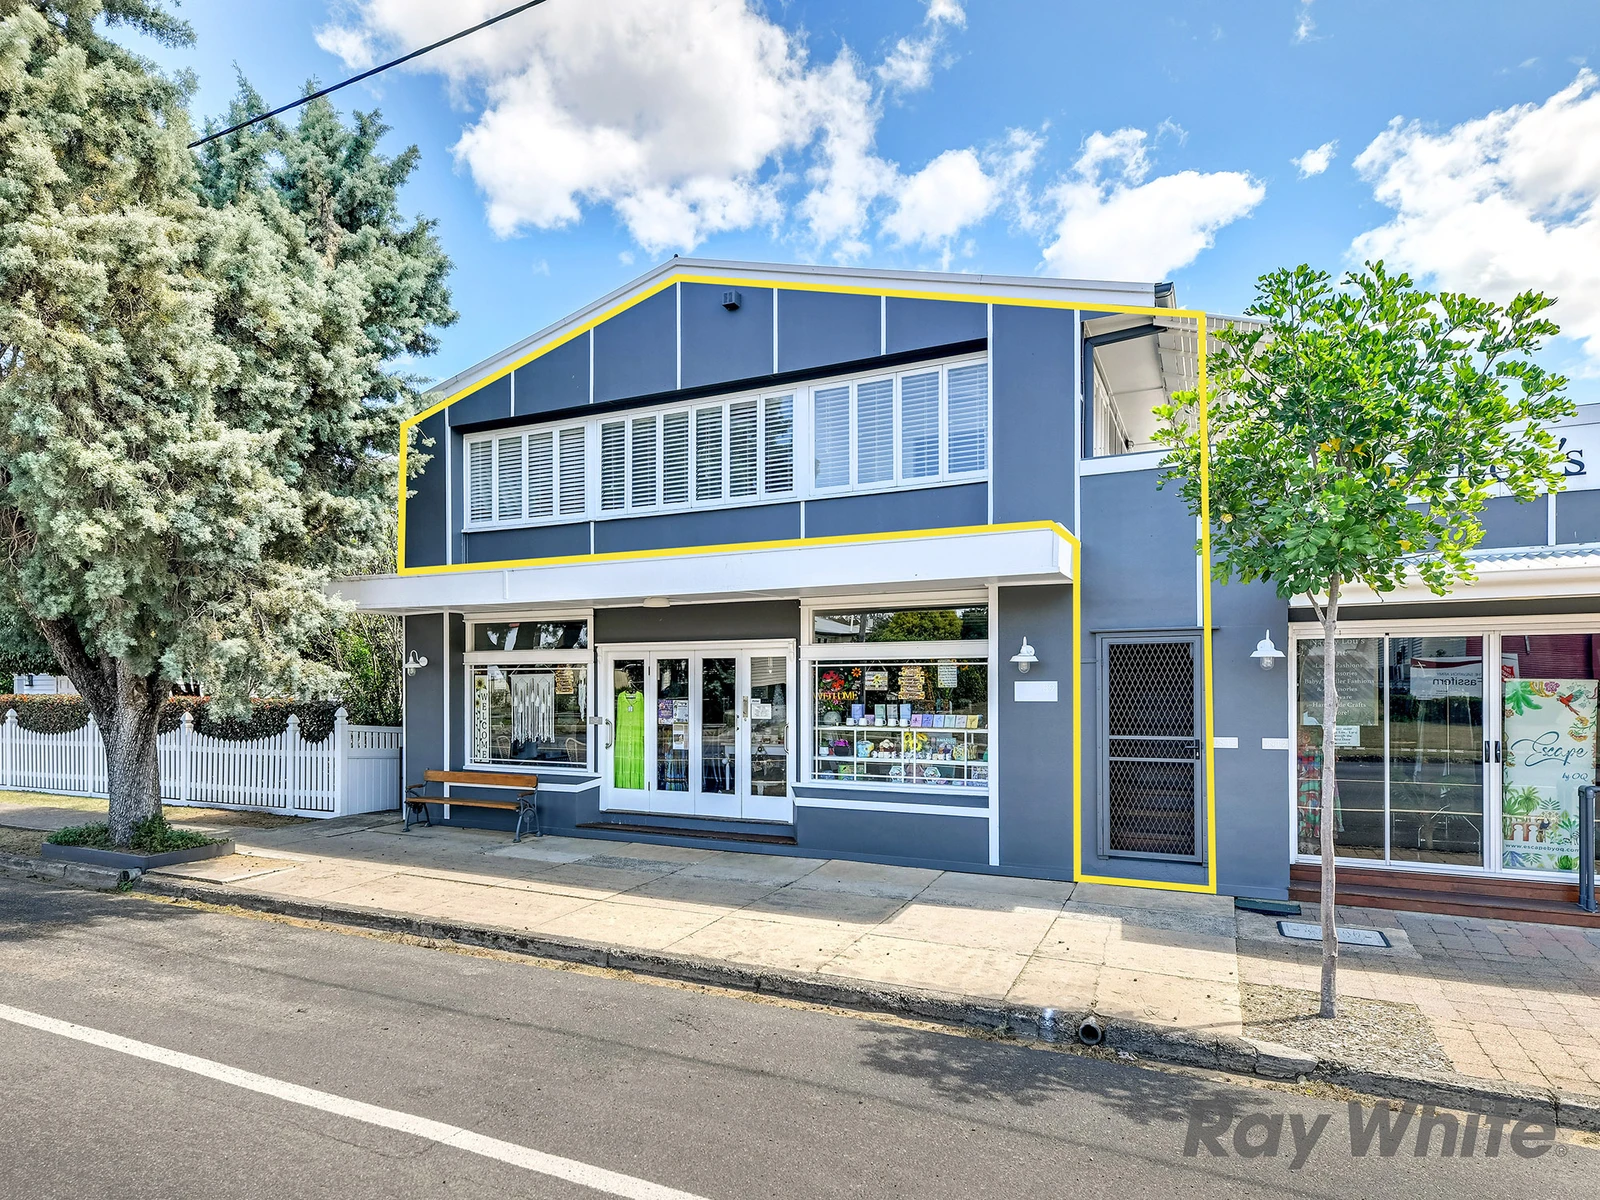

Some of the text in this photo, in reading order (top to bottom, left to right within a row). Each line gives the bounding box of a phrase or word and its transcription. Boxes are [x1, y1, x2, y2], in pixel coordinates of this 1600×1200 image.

[480, 692, 488, 759] WELCOME
[1510, 731, 1588, 767] Escape
[1562, 772, 1588, 781] by OQ
